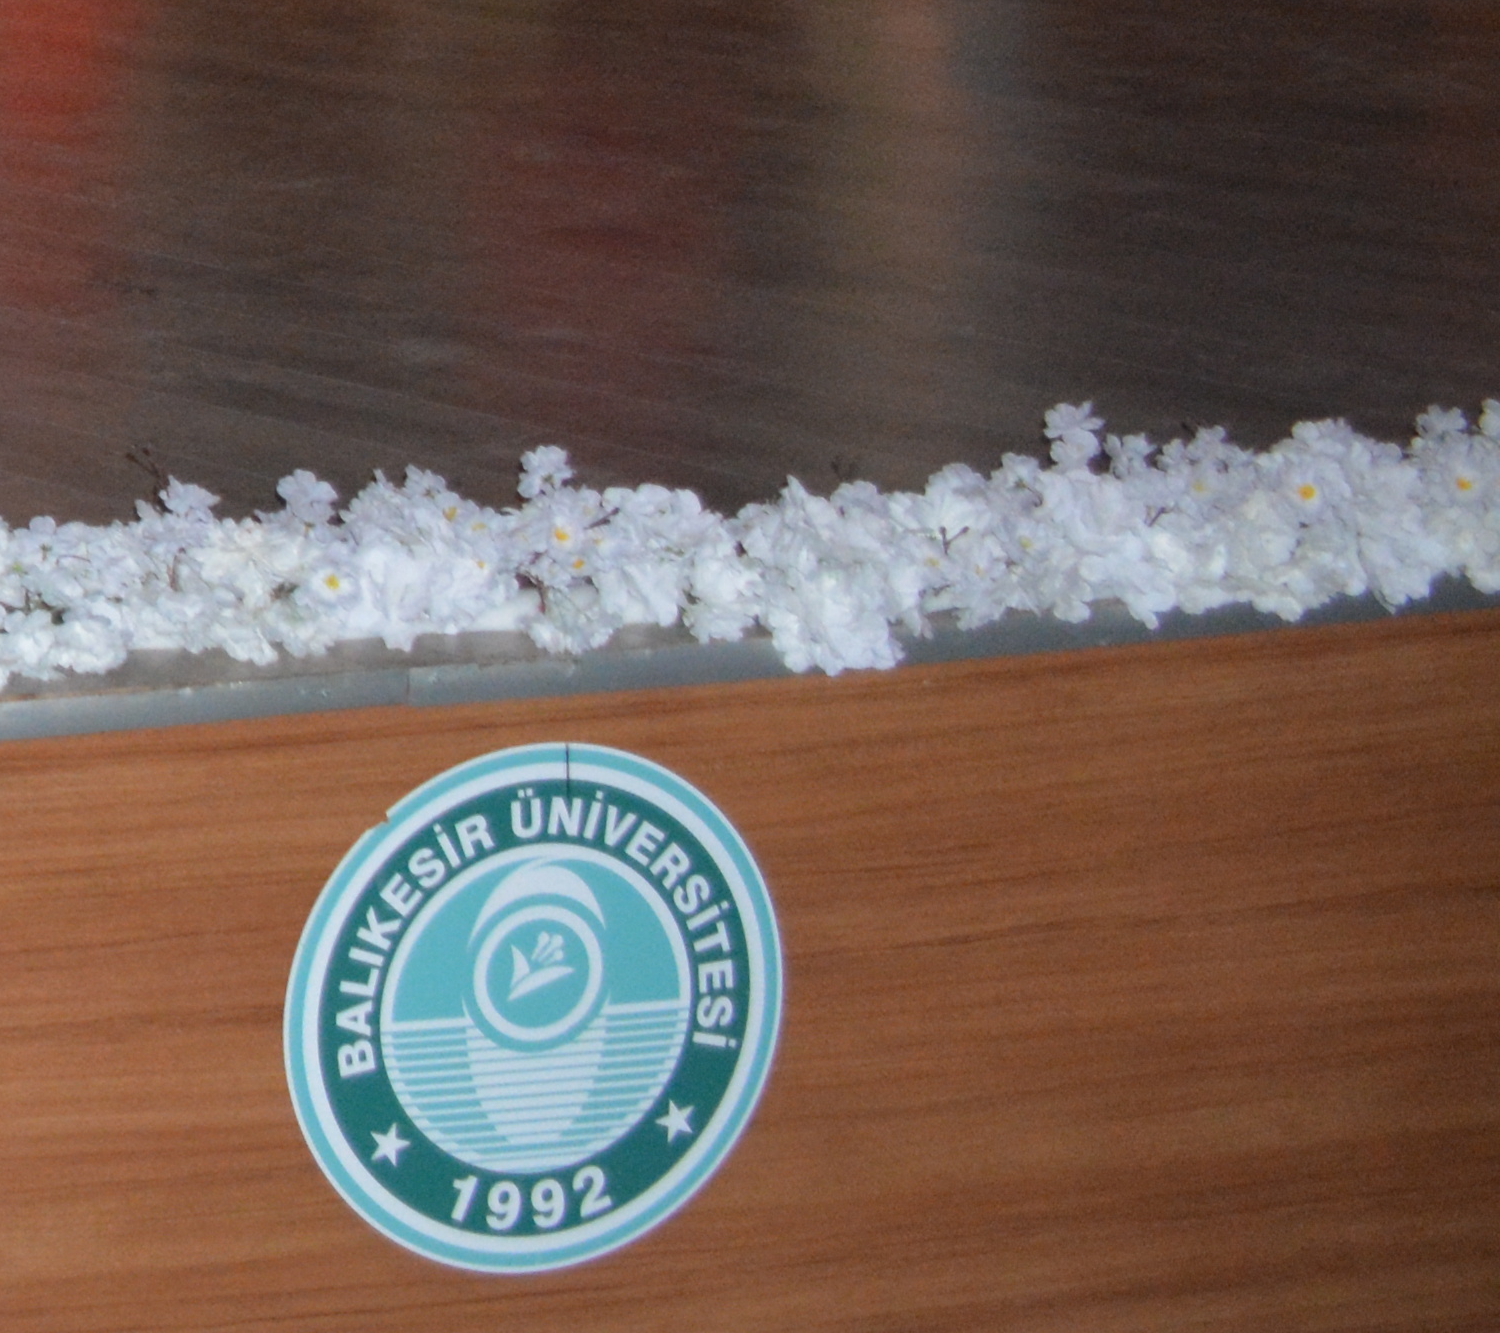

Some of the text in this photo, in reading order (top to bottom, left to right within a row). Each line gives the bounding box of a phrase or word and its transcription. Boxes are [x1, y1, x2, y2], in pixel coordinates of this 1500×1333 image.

[336, 787, 739, 1080] BALIKESİR ÜNİVERSİTESİ
[449, 1165, 614, 1231] 1992
